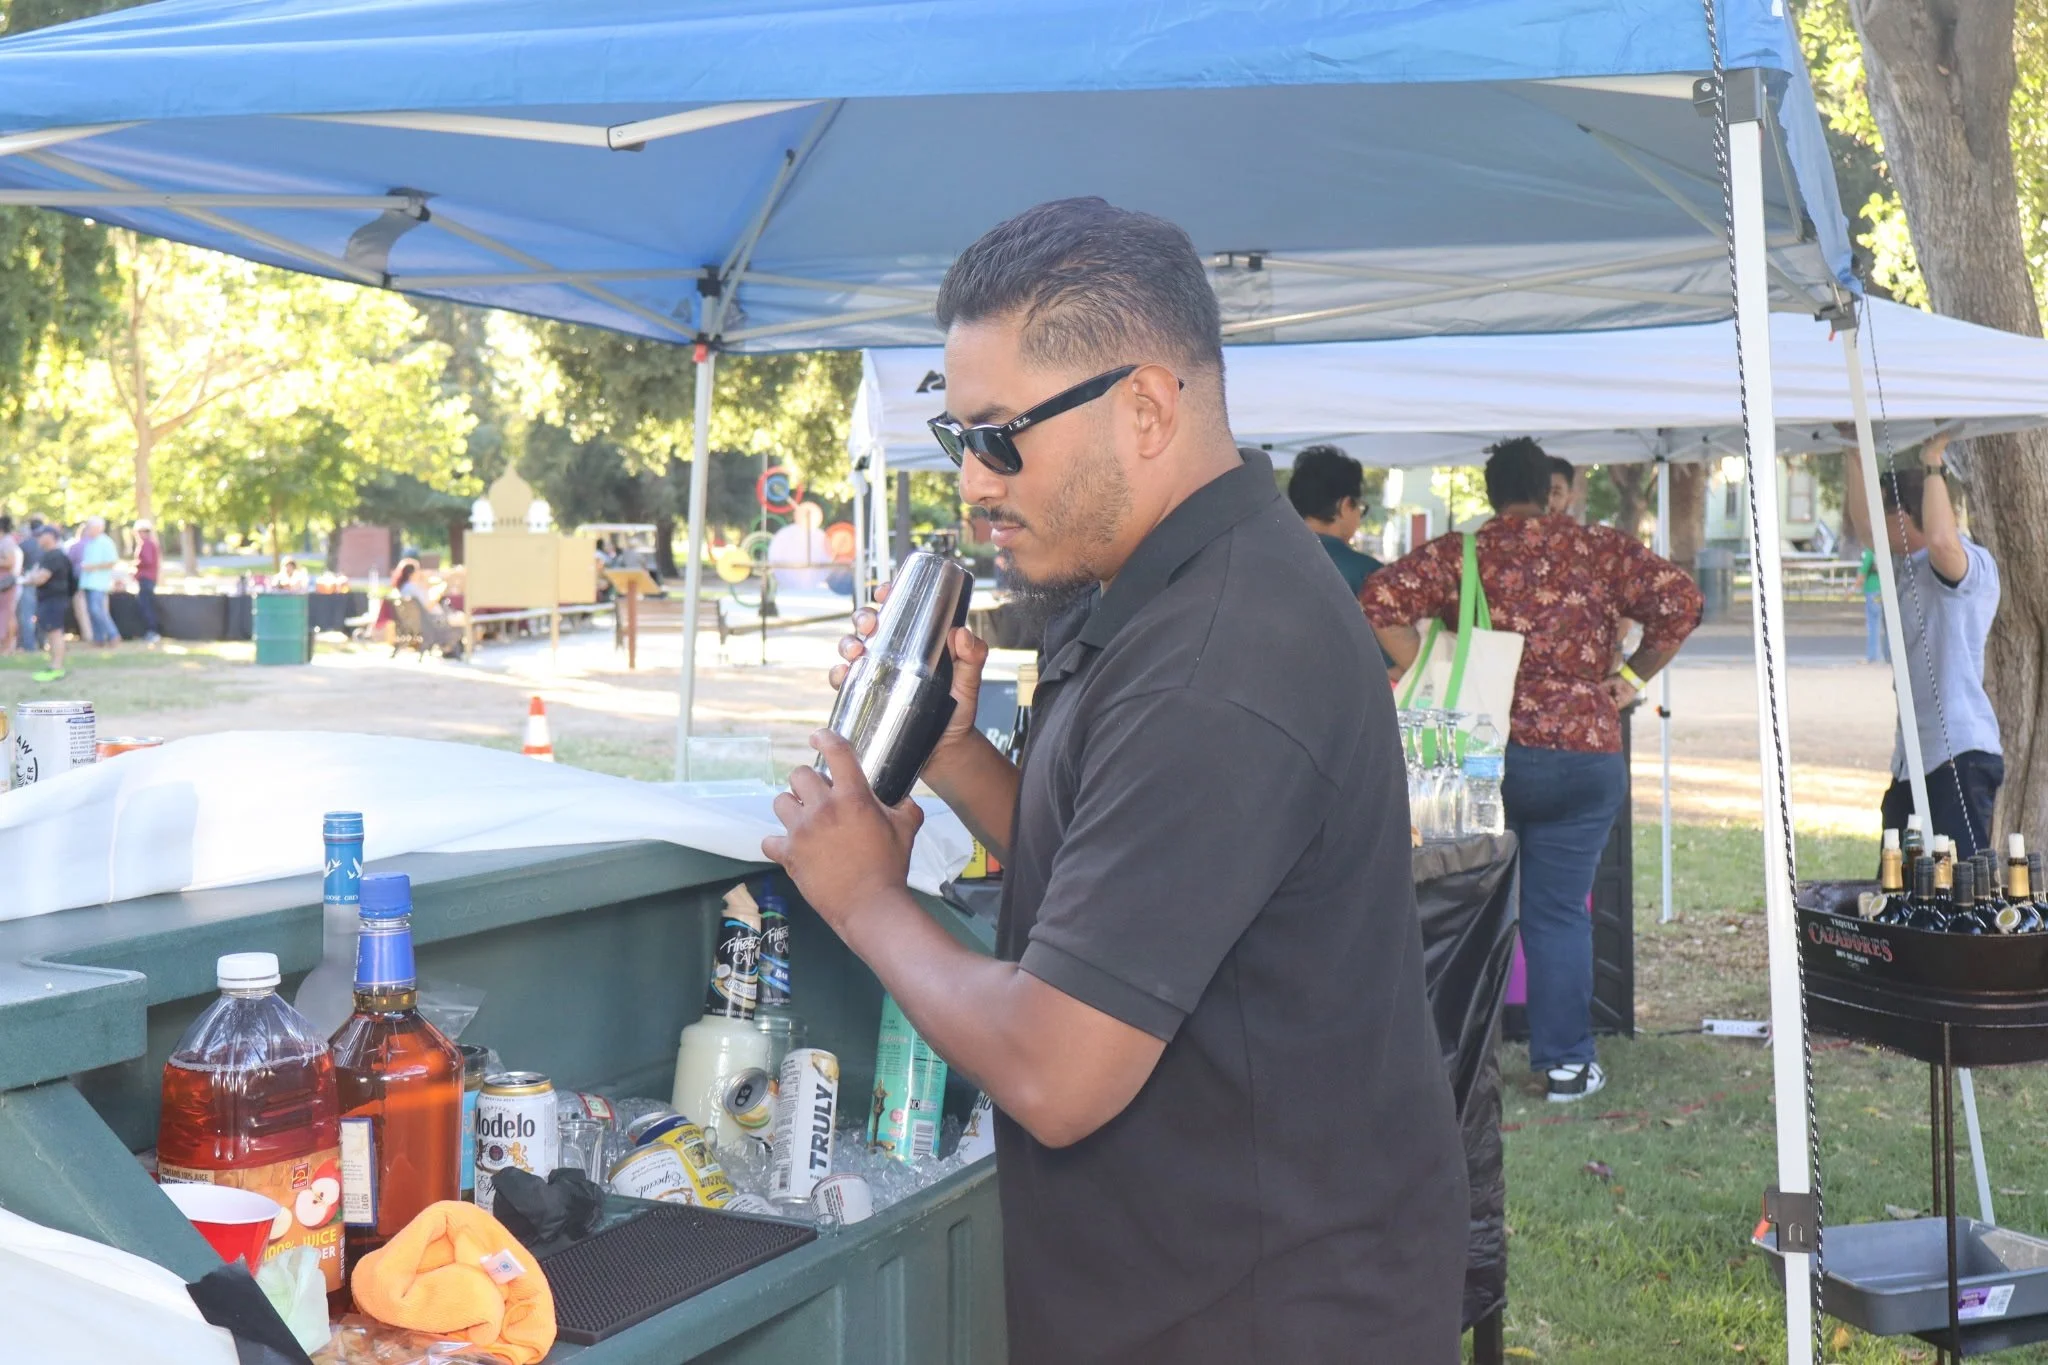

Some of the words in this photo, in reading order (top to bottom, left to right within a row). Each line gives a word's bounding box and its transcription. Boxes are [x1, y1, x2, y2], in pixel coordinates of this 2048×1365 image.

[761, 925, 789, 943] Fines
[1830, 918, 1860, 931] TEQUILA
[720, 930, 760, 953] Finest
[1808, 921, 1893, 962] CAZADORES
[809, 1083, 833, 1170] TRULY
